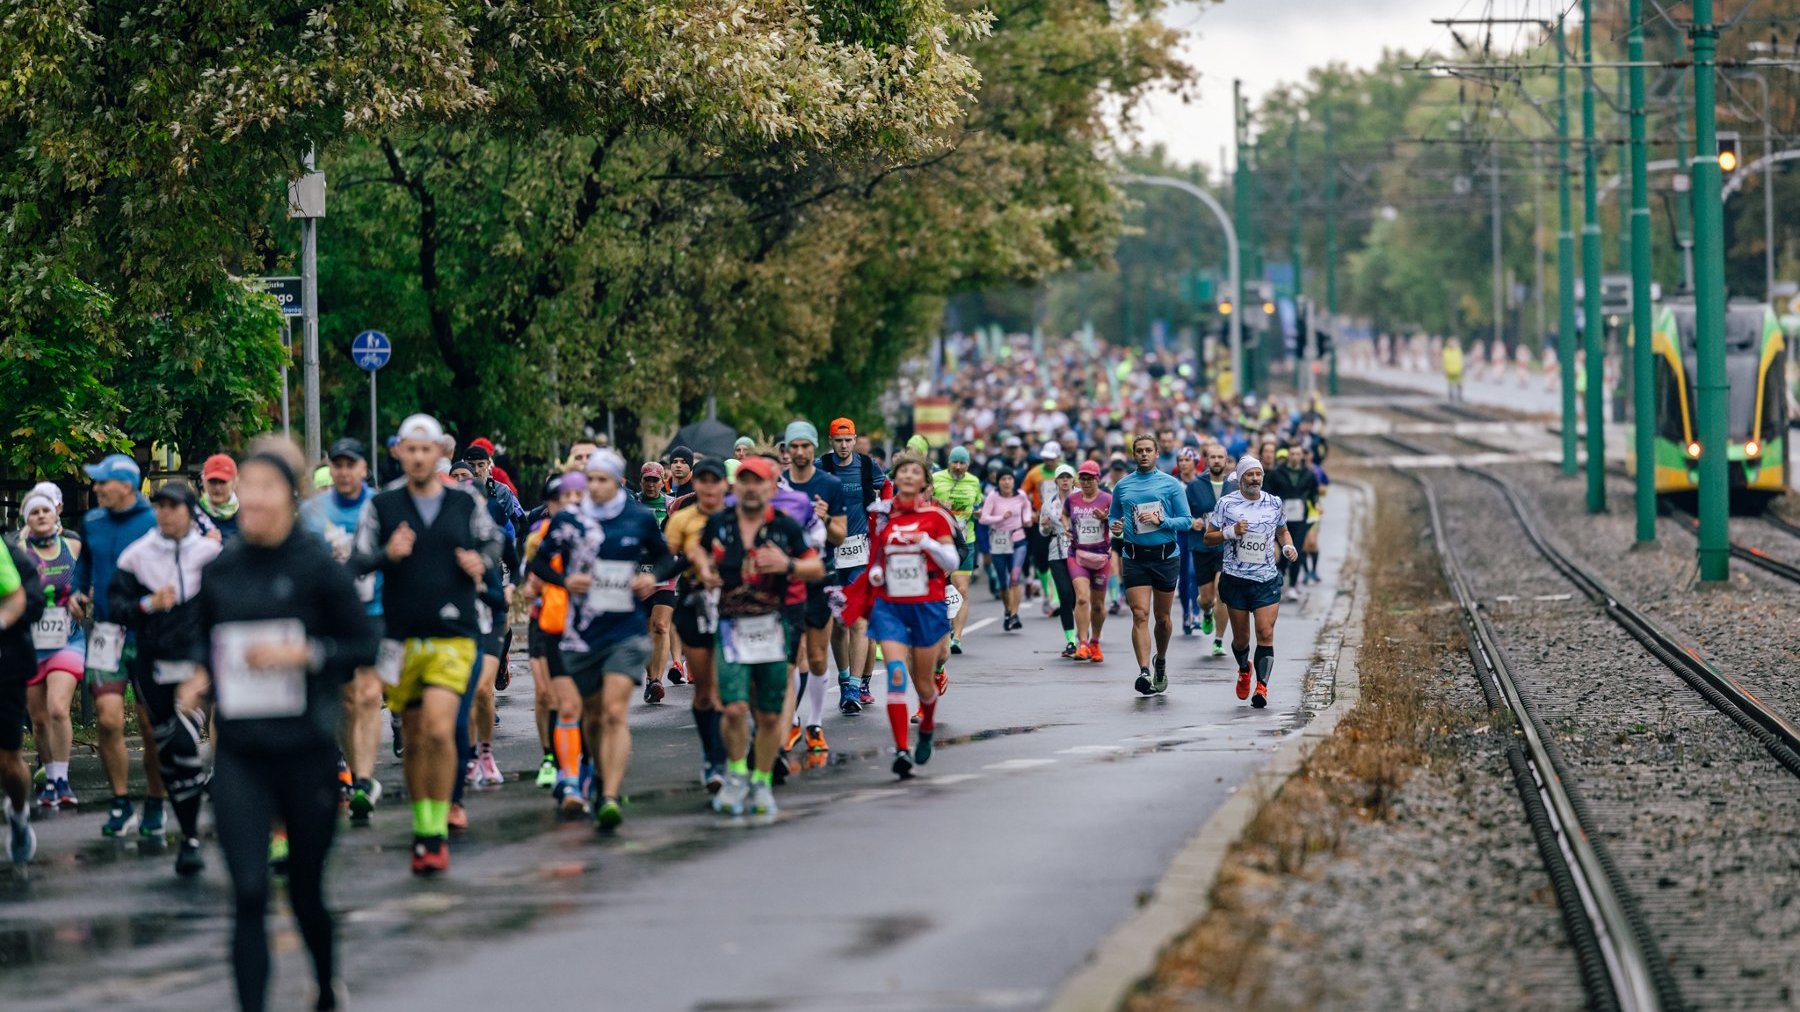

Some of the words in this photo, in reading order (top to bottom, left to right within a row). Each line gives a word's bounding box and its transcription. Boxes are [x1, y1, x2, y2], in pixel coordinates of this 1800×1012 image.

[1082, 526, 1100, 534] 2531
[840, 545, 862, 556] 3381
[1240, 541, 1266, 551] 4500
[37, 621, 64, 632] 1072
